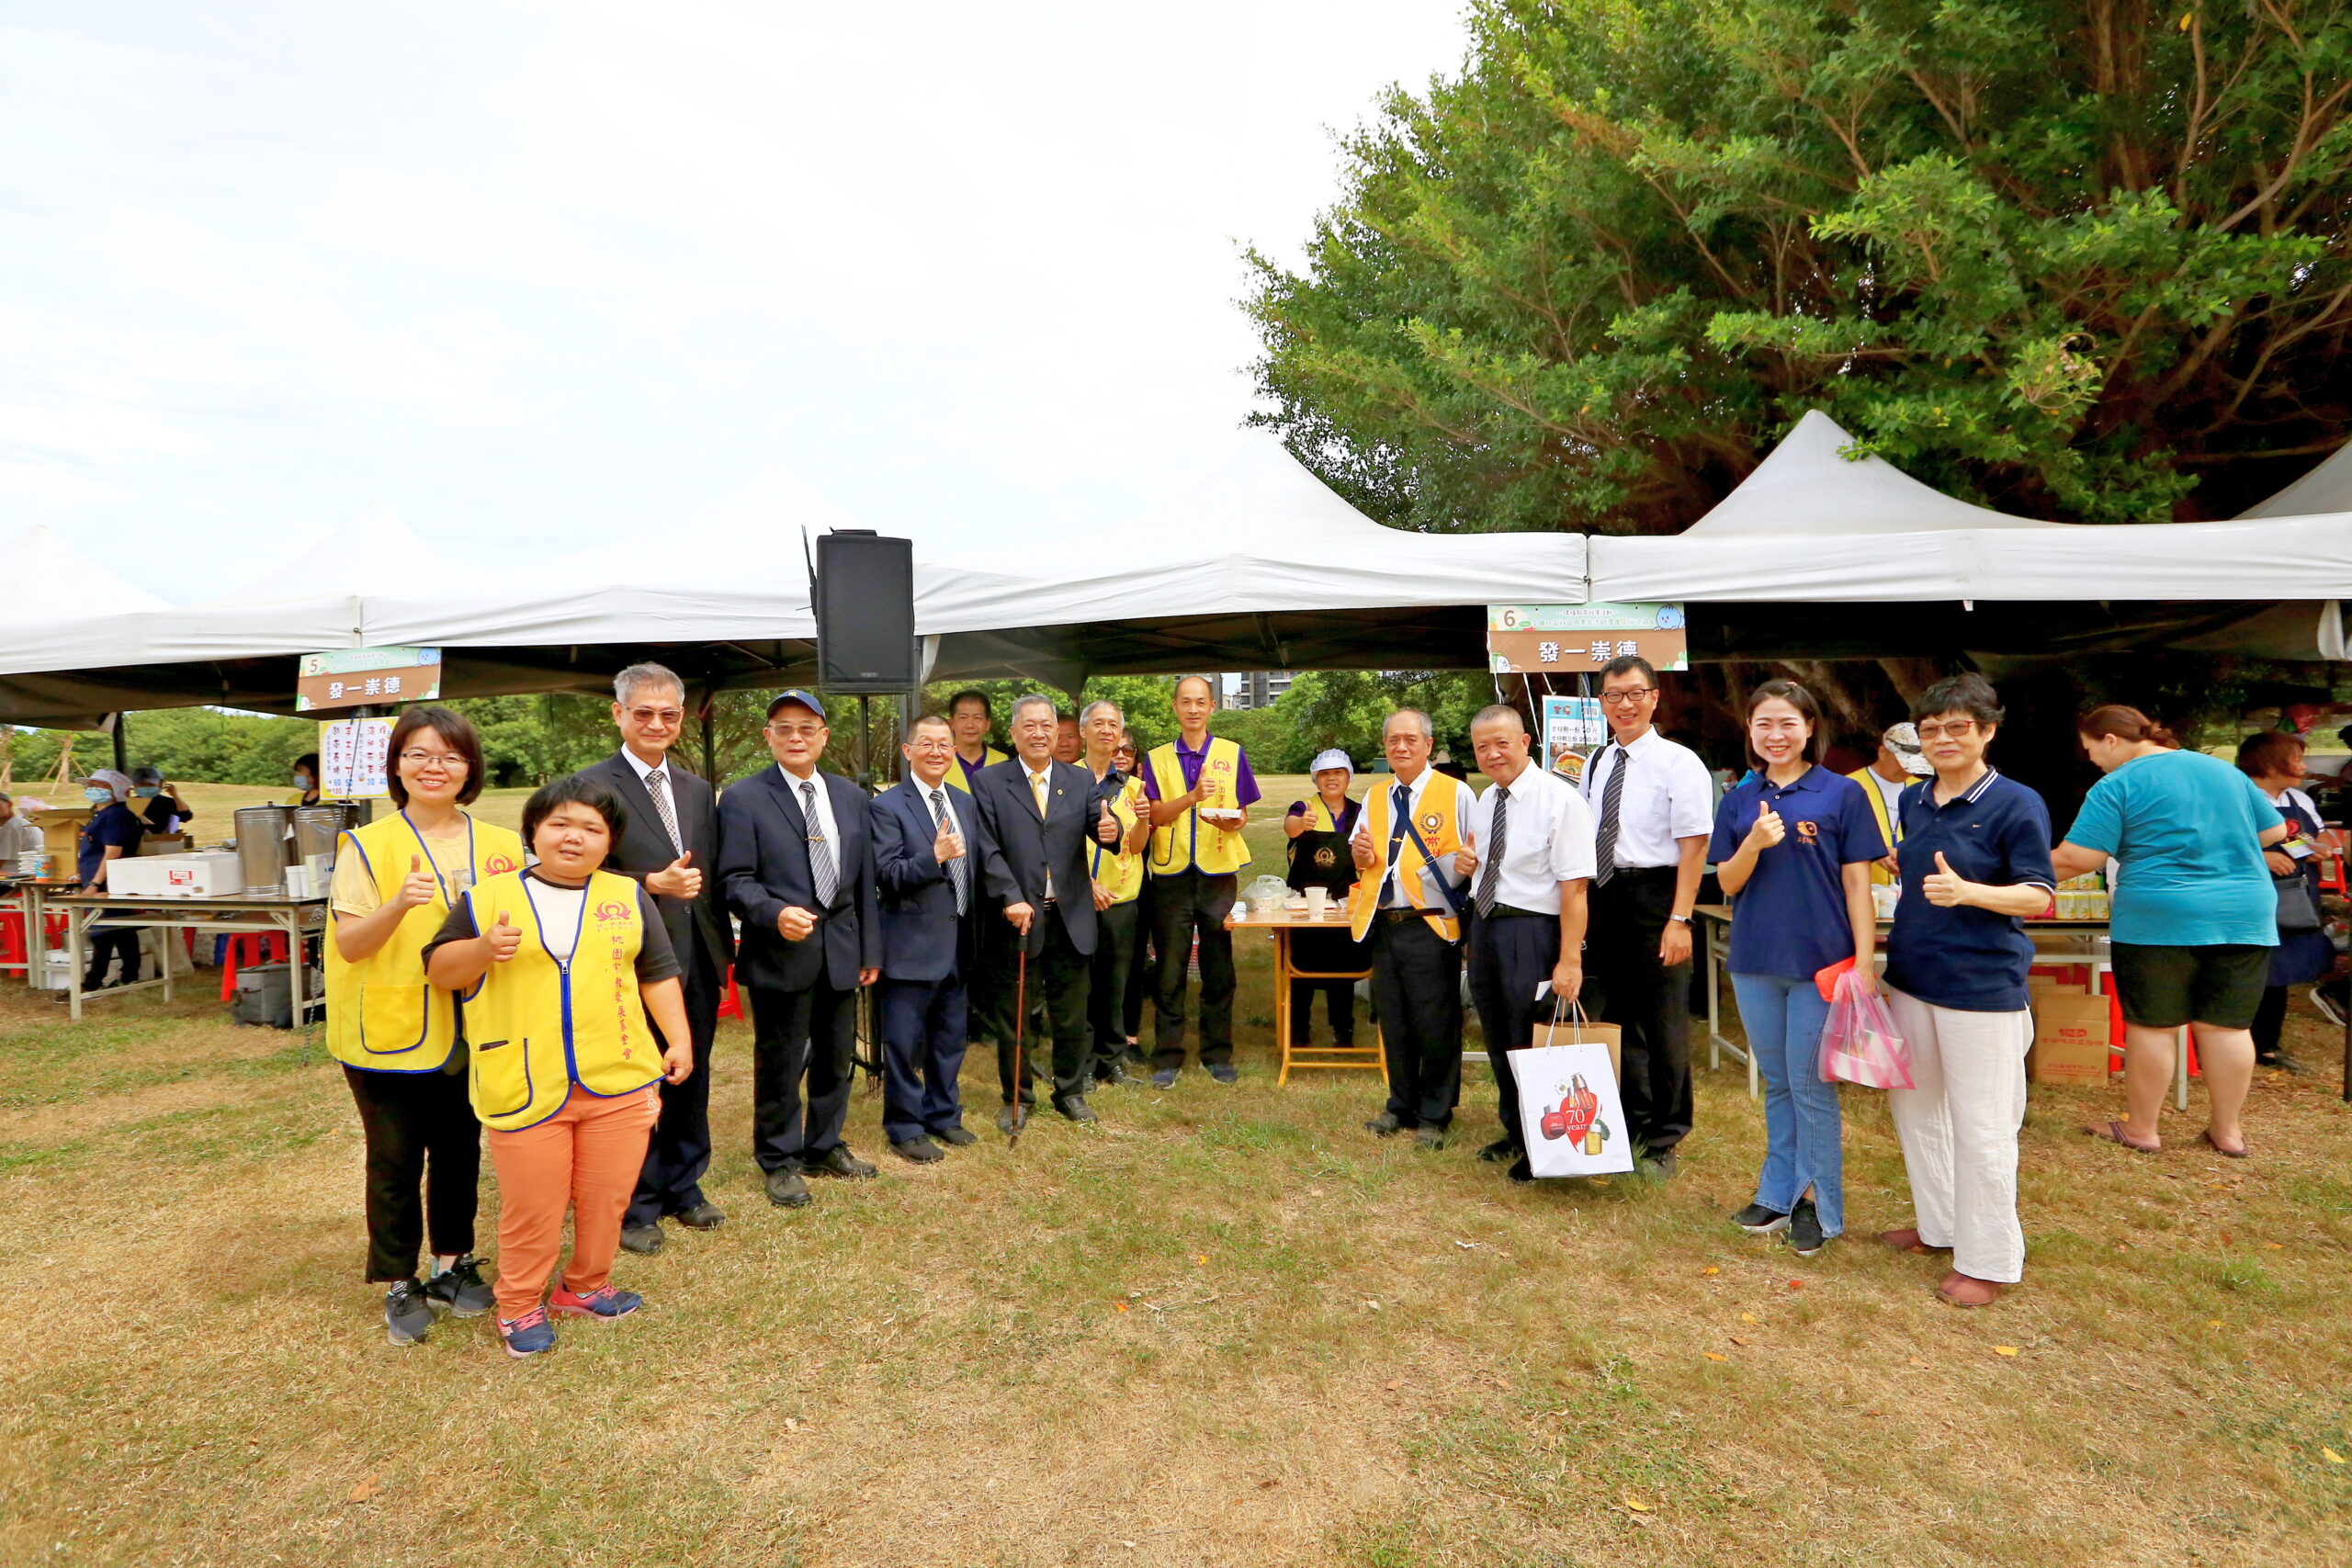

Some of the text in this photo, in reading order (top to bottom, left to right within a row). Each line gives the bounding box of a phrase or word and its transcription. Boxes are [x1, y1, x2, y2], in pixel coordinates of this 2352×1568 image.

[1503, 609, 1515, 627] 6
[1538, 639, 1639, 663] 發一崇德
[310, 659, 318, 673] 5
[329, 675, 401, 700] 發一崇德
[1566, 1109, 1585, 1124] 70
[1566, 1124, 1588, 1134] years
